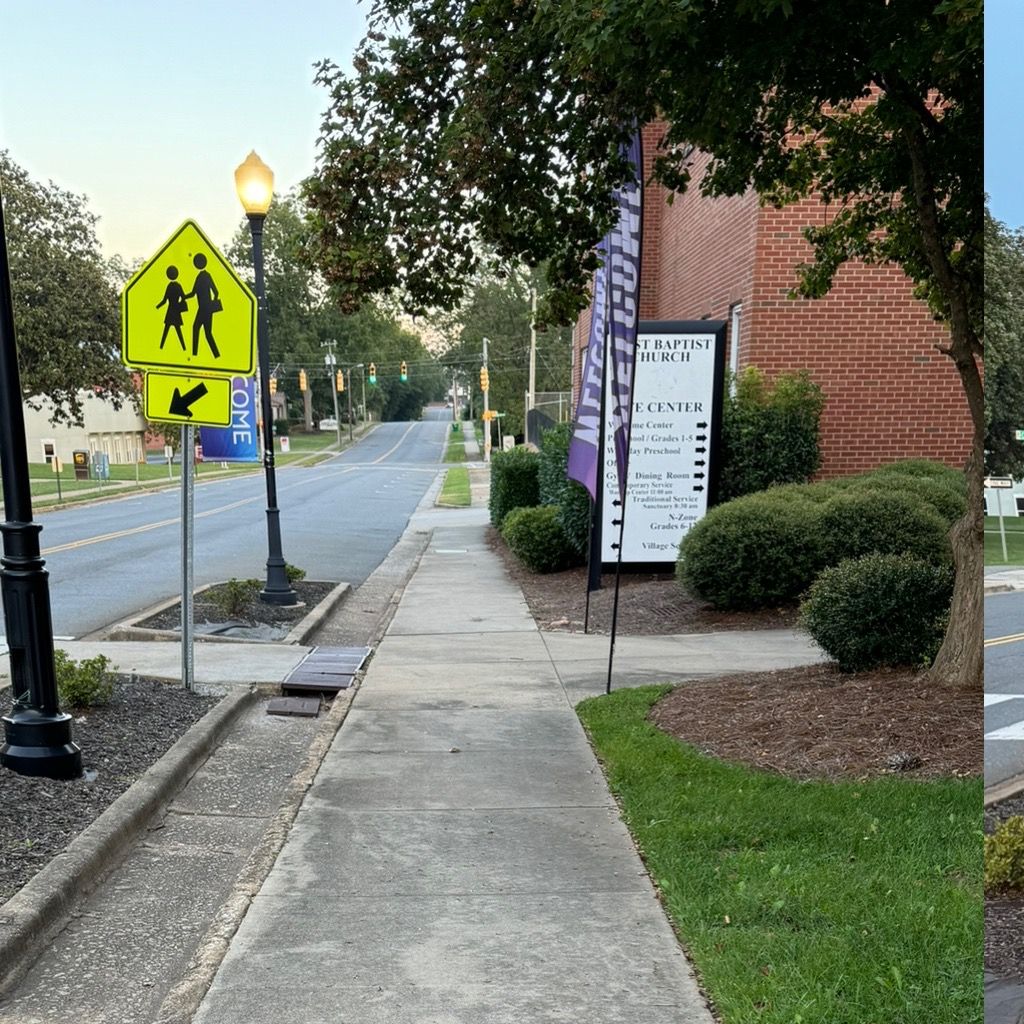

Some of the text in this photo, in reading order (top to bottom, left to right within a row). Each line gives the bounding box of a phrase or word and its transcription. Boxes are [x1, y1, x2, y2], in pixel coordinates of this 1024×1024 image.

[654, 339, 712, 350] BAPTIST
[637, 351, 690, 362] HURCH
[647, 402, 703, 413] CENTER
[646, 422, 673, 430] Center
[651, 434, 679, 443] Grades
[681, 434, 693, 442] 1-5
[644, 447, 681, 455] Preschool
[635, 471, 662, 481] Dining
[666, 471, 689, 479] Room
[650, 522, 678, 530] Grades
[642, 542, 668, 550] Village
